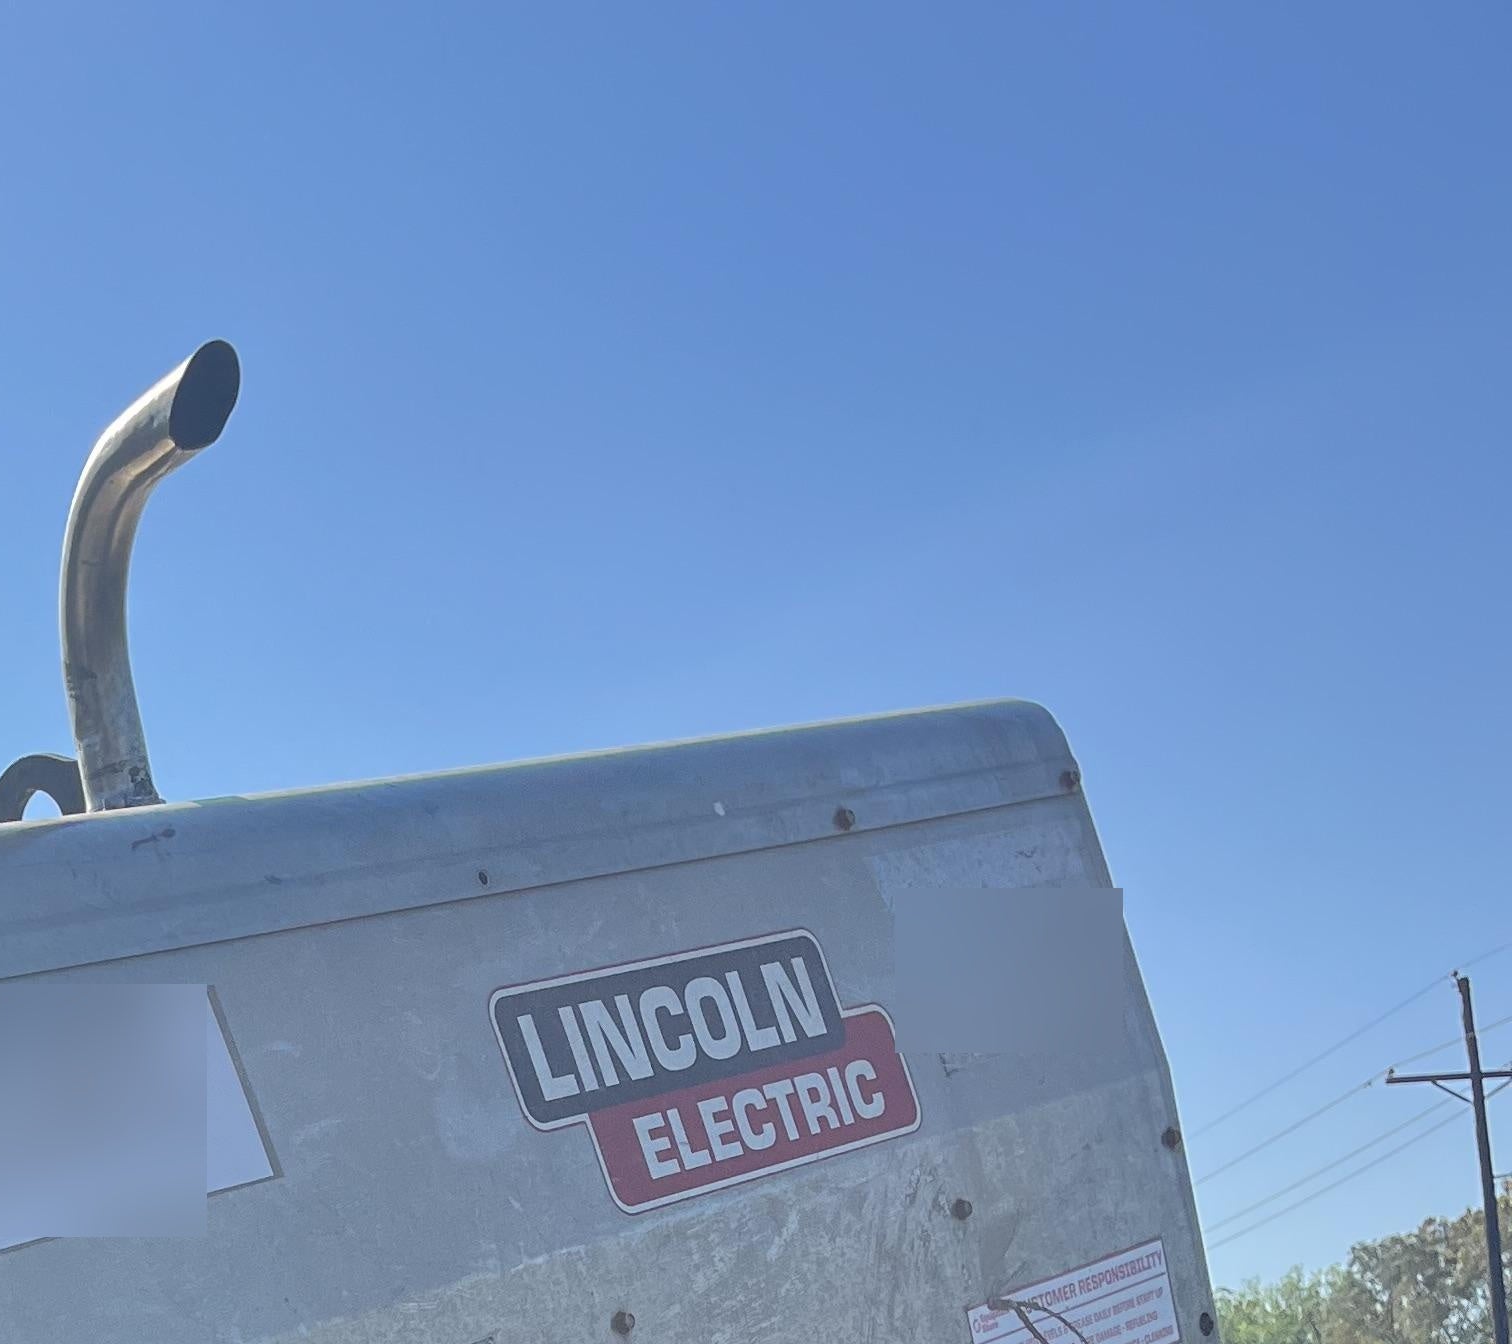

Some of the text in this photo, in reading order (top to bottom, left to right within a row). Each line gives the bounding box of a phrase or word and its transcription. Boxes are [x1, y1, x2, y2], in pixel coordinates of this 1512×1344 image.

[516, 957, 828, 1102] LINCOLN
[632, 1060, 885, 1180] ELECTRIC
[1022, 1281, 1077, 1316] USTOMER
[1077, 1248, 1163, 1295] RESPONSIBILITY
